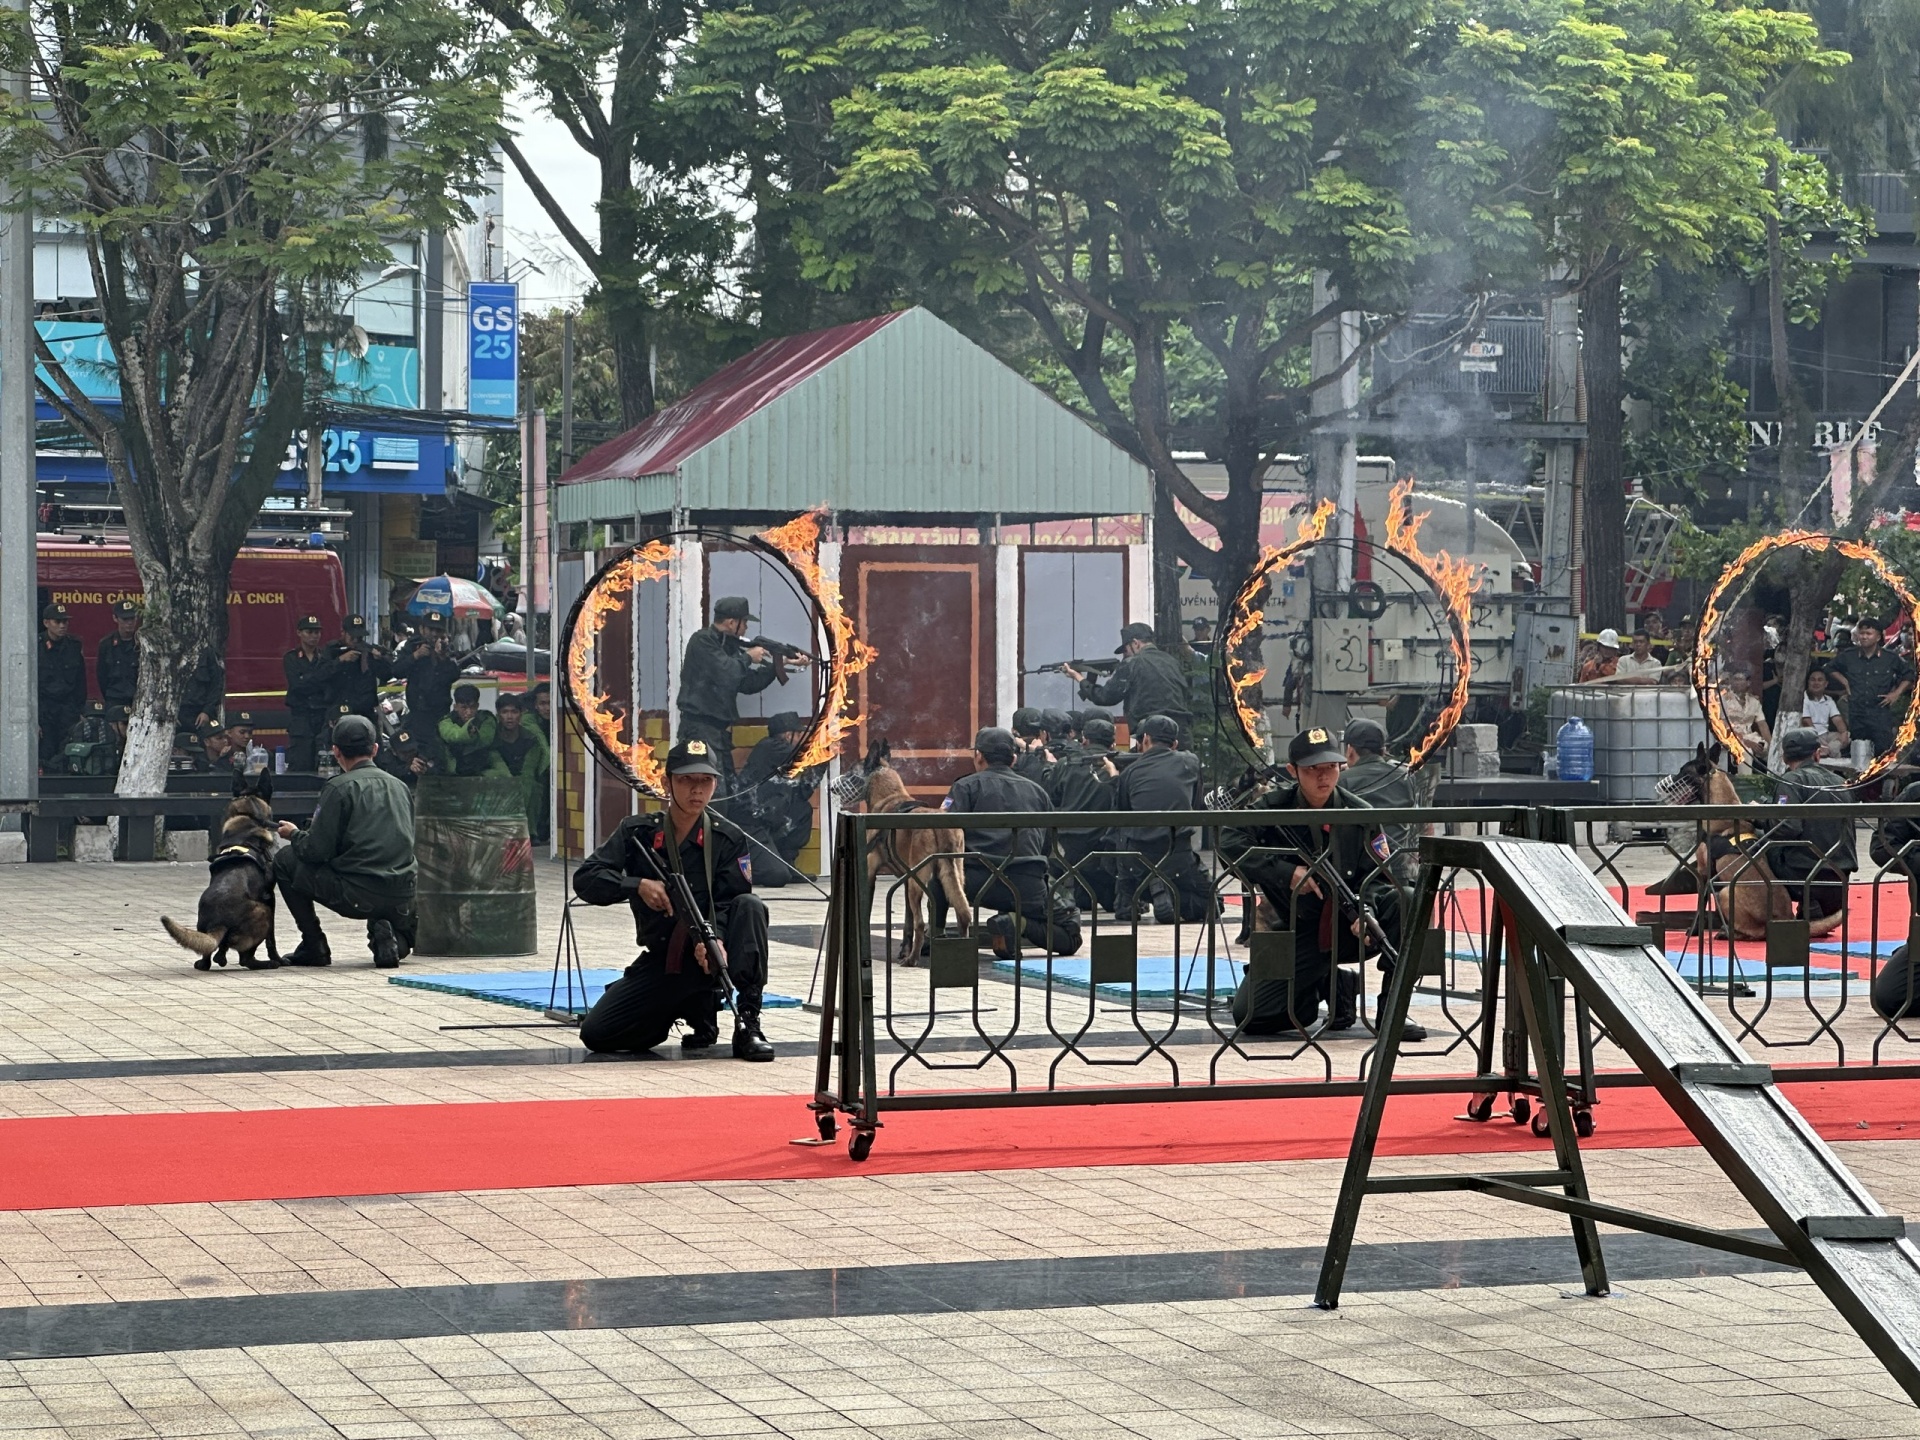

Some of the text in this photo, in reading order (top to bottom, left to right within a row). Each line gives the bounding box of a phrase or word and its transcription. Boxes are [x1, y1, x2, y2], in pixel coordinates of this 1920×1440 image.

[472, 305, 514, 332] GS
[474, 334, 512, 360] 25
[52, 589, 103, 604] PHÒNG
[246, 592, 285, 604] CNCH
[1180, 592, 1207, 606] UYỂN
